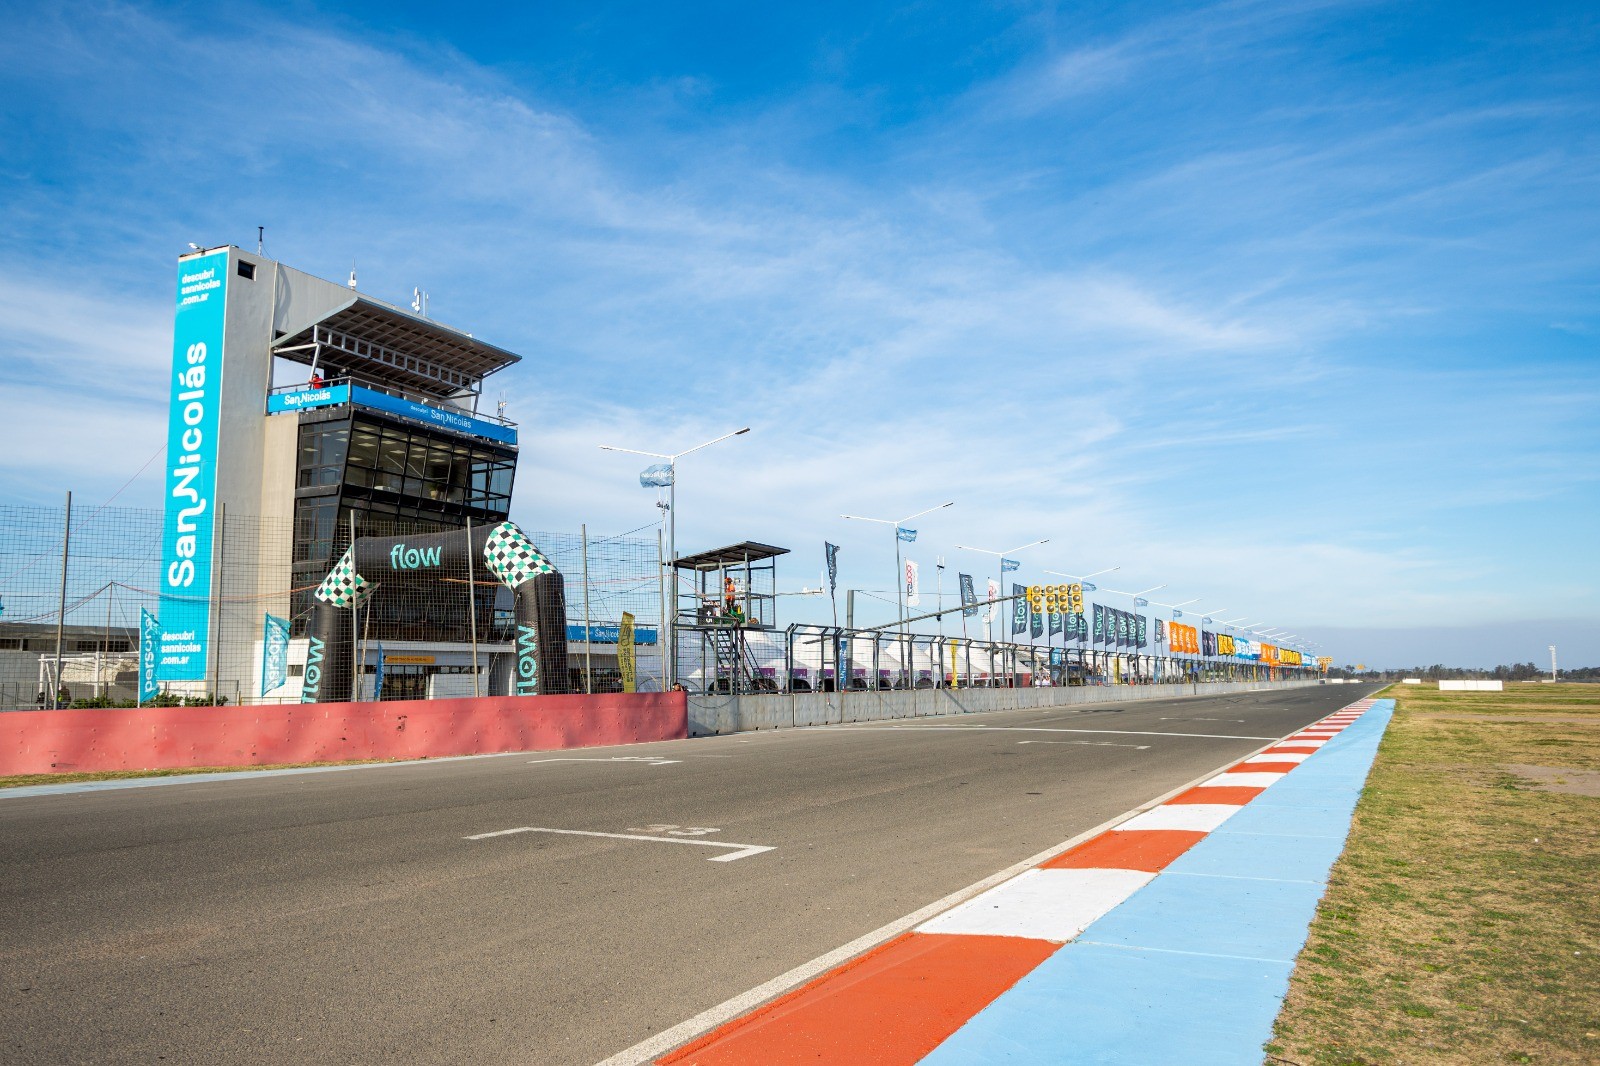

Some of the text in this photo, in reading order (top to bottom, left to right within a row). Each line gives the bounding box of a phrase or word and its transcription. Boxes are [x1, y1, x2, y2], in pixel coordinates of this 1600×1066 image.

[180, 293, 209, 305] .com.ar
[168, 341, 207, 588] San Nicolás
[390, 543, 442, 569] flow
[301, 635, 325, 704] flow
[516, 625, 538, 696] flow
